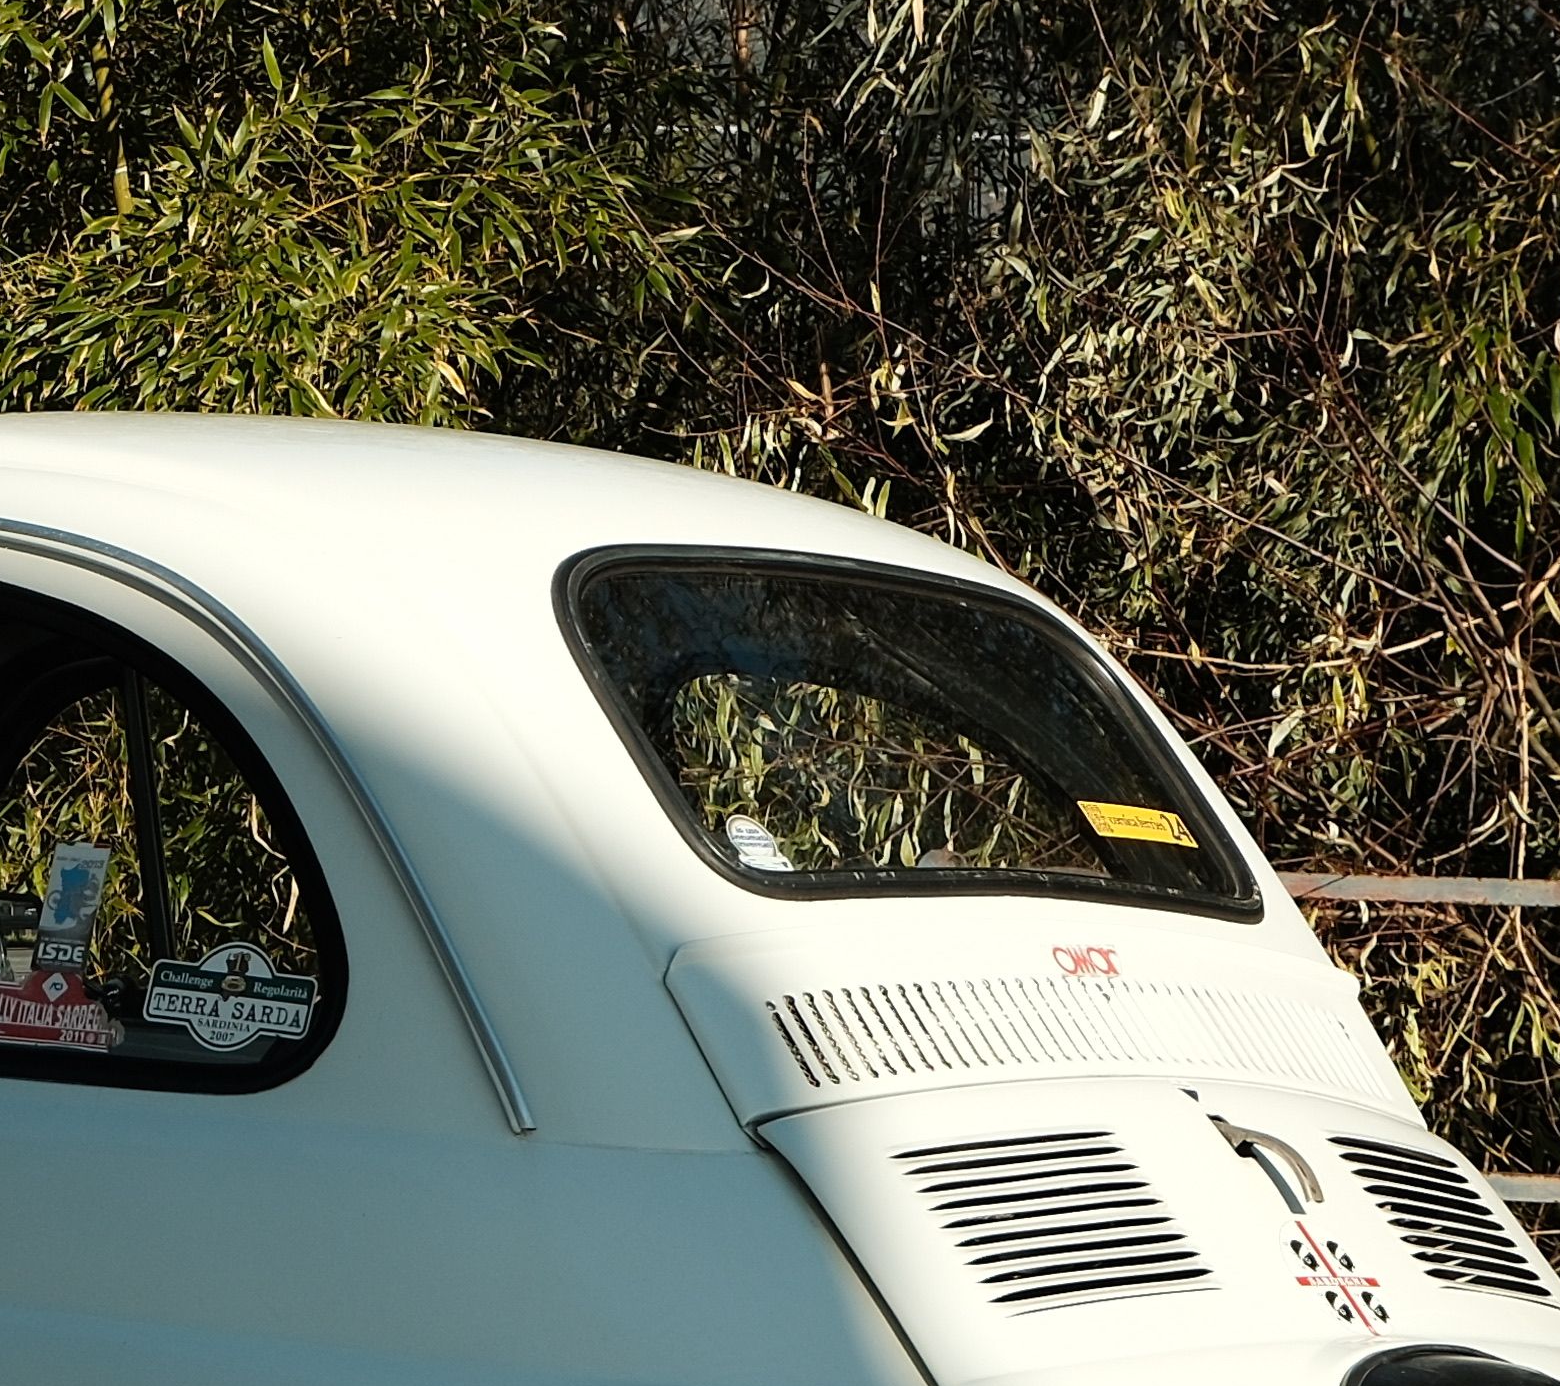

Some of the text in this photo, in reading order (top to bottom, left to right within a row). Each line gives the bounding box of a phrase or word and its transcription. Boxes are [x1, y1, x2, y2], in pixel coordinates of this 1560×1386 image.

[160, 970, 308, 999] Challenge Regolarità
[16, 999, 54, 1026] ITALIA
[54, 1003, 103, 1031] SARDEG
[153, 993, 302, 1029] TERRA SARDA
[59, 1030, 85, 1042] 2011
[197, 1018, 251, 1033] SARDINIA
[209, 1031, 235, 1042] 2007
